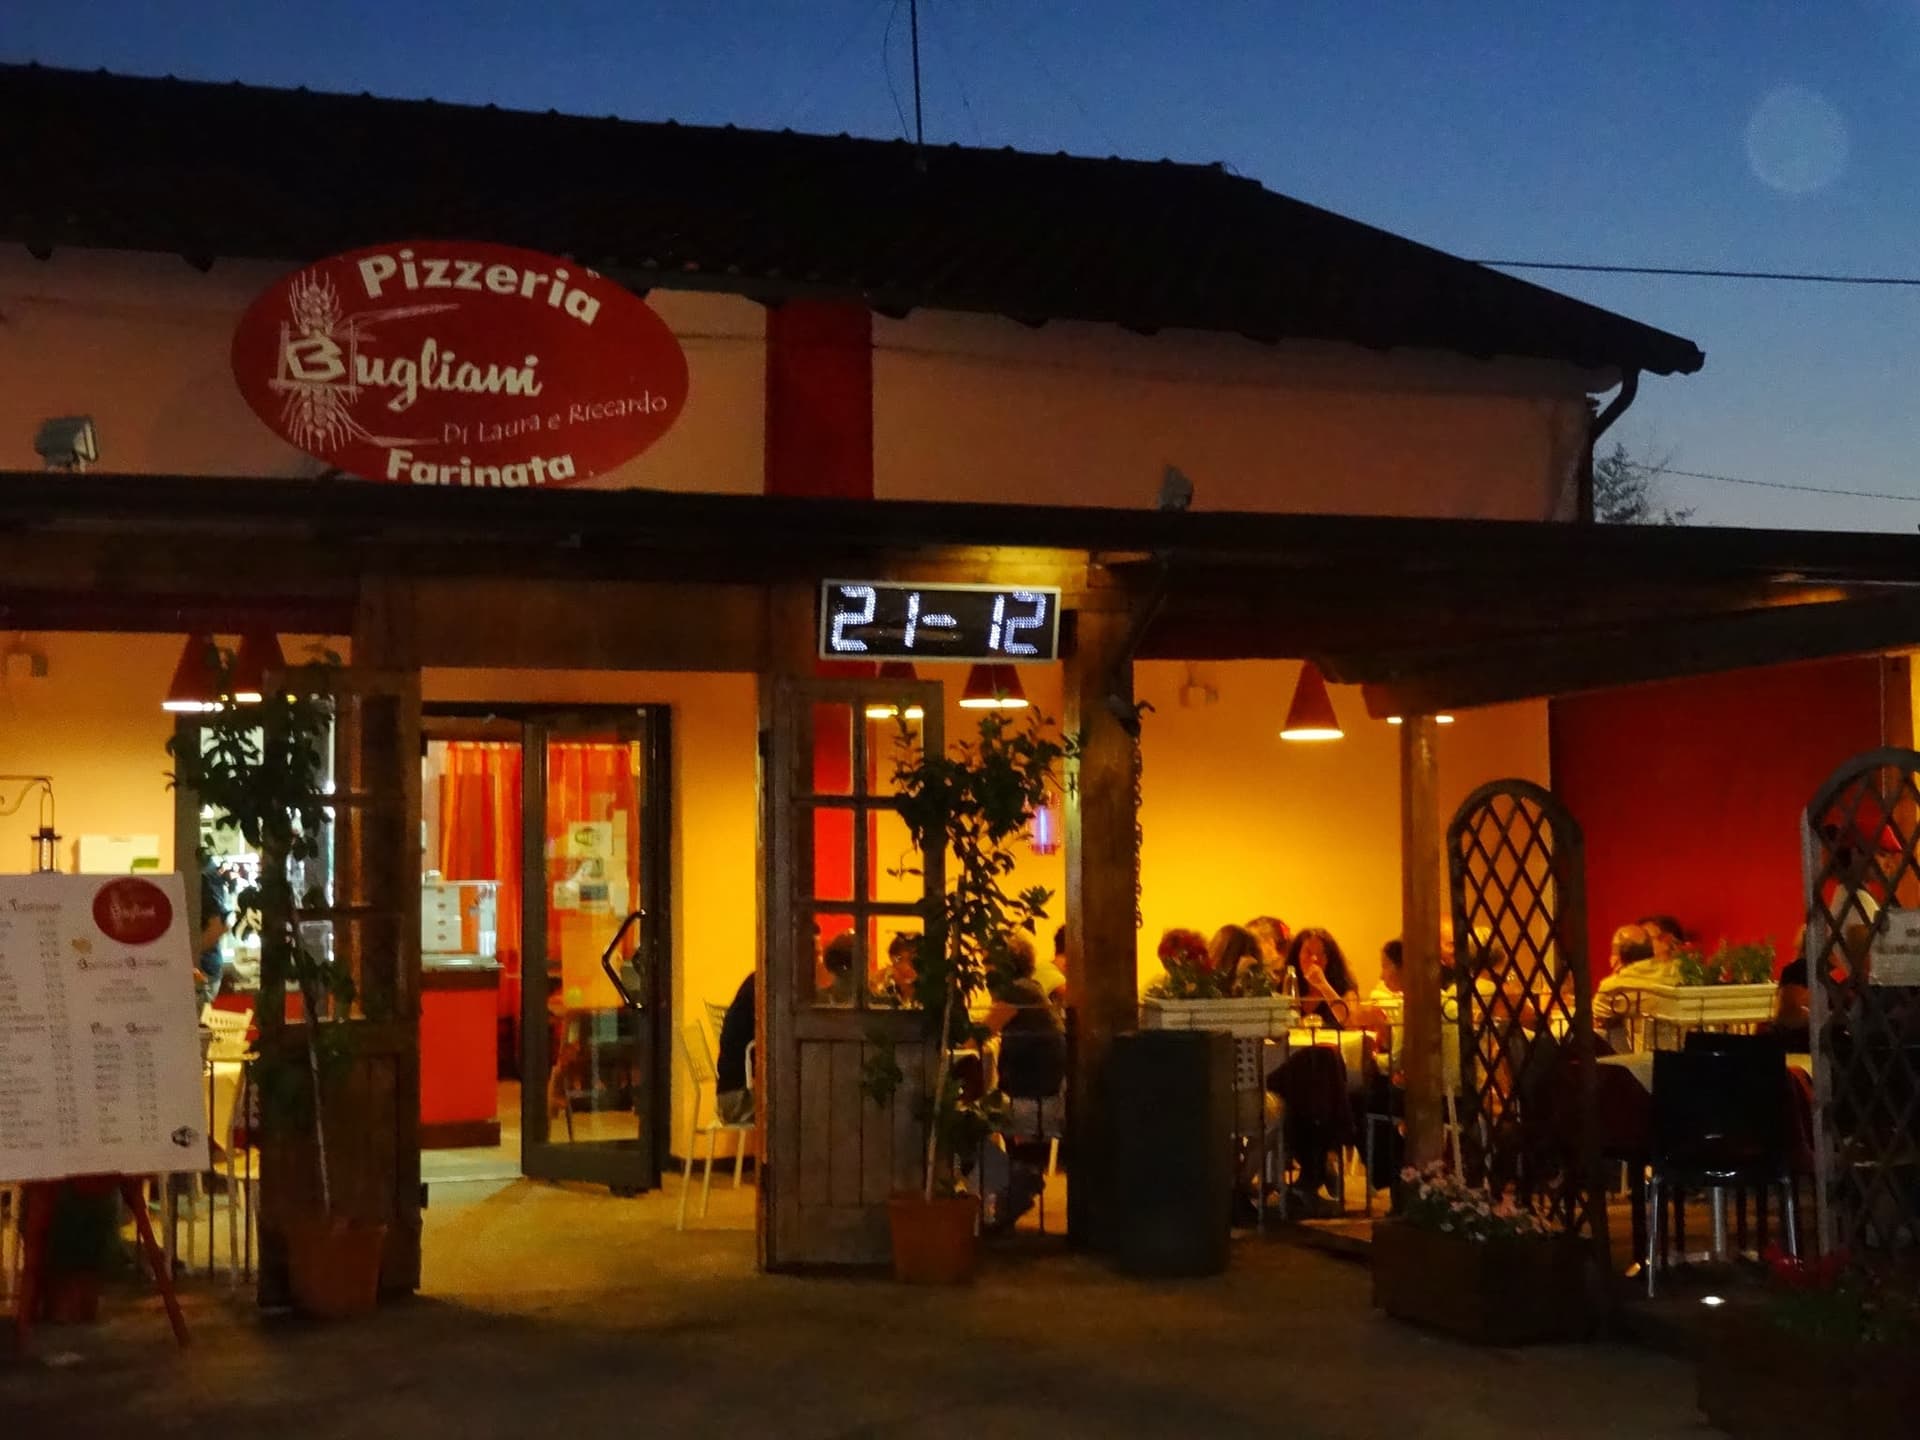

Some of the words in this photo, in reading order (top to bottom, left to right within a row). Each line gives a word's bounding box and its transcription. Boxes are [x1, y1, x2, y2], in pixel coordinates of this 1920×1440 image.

[358, 249, 601, 325] Pizzeria
[286, 331, 543, 411] Bugliani
[479, 413, 541, 443] Laura
[547, 413, 561, 430] e
[569, 389, 668, 425] Riccardo
[386, 448, 576, 488] Farinata
